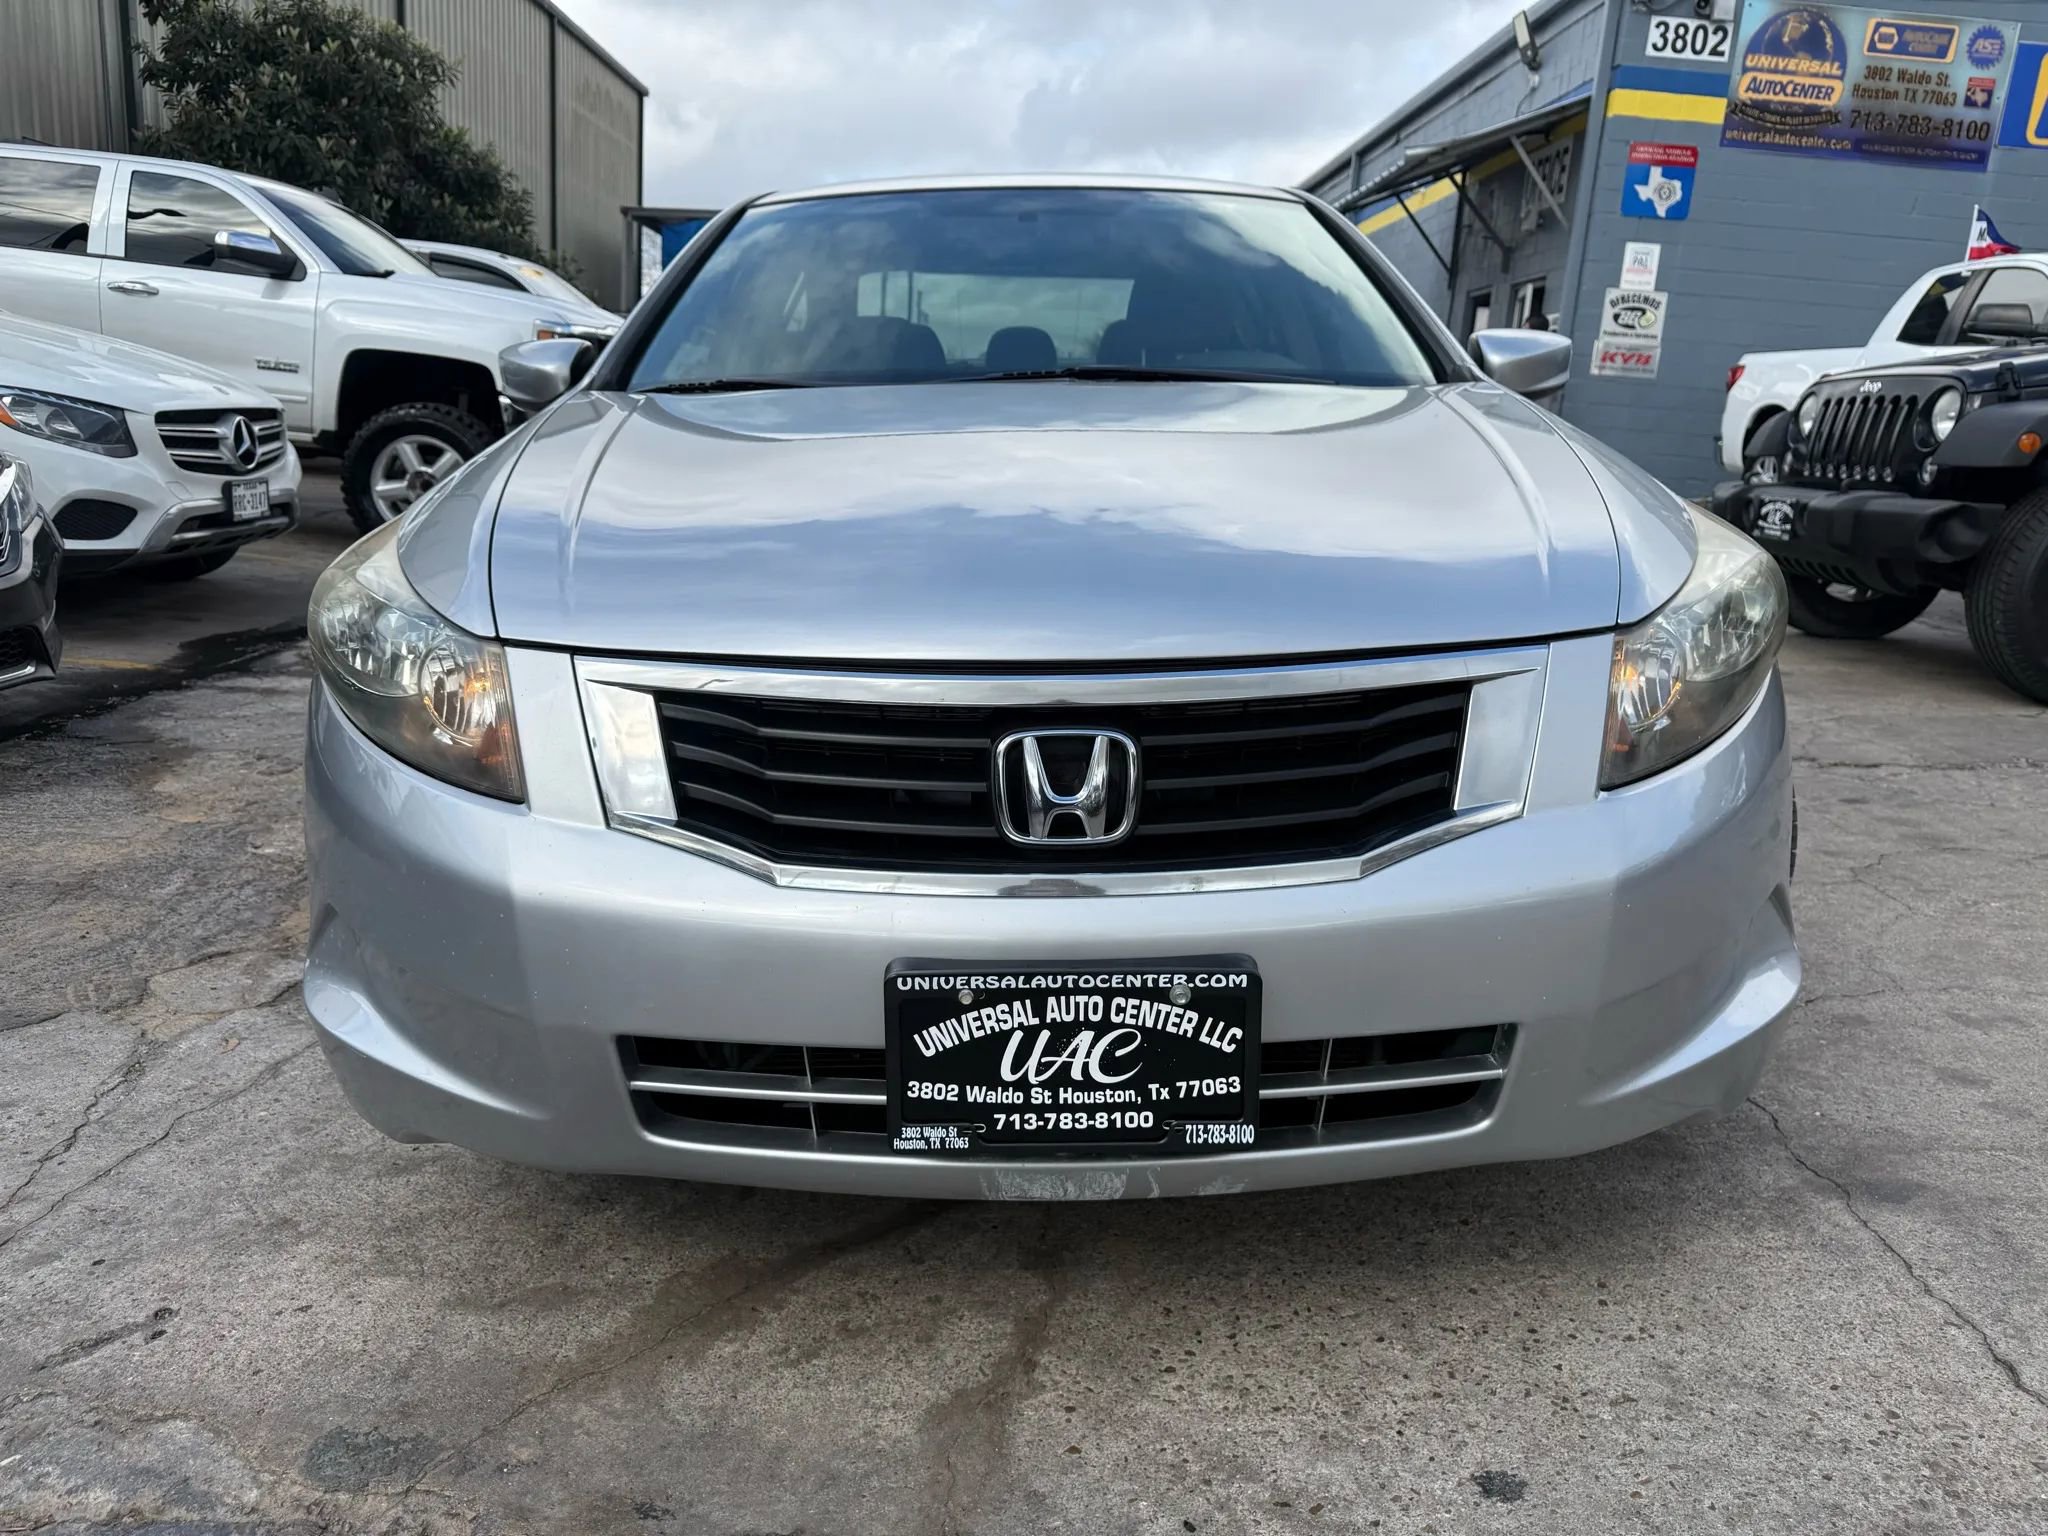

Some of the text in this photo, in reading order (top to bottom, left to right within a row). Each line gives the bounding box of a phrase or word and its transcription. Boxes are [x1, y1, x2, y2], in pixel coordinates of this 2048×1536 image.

[1651, 21, 1729, 57] 3802
[1745, 53, 1843, 76] UNIVERSAL
[1864, 65, 1893, 82] 3802
[1897, 67, 1932, 86] Waldo
[1936, 71, 1951, 88] St.
[1852, 84, 1957, 108] Houston TX 77063
[1850, 109, 1991, 143] 713-783-8100
[897, 974, 1248, 991] UNIVERSALAUTOCENTER.COM
[913, 995, 1243, 1058] UNIVERSAL AUTO CENTER LLC
[1000, 1028, 1143, 1085] UAC
[907, 1076, 1241, 1105] 3802 Waldo St Houston, Tx 77063
[901, 1126, 958, 1139] 3802 Waldo St
[993, 1111, 1154, 1131] 713-783-8100
[893, 1137, 969, 1150] Houston, TX 77063
[1185, 1124, 1255, 1145] 713-783-8100
